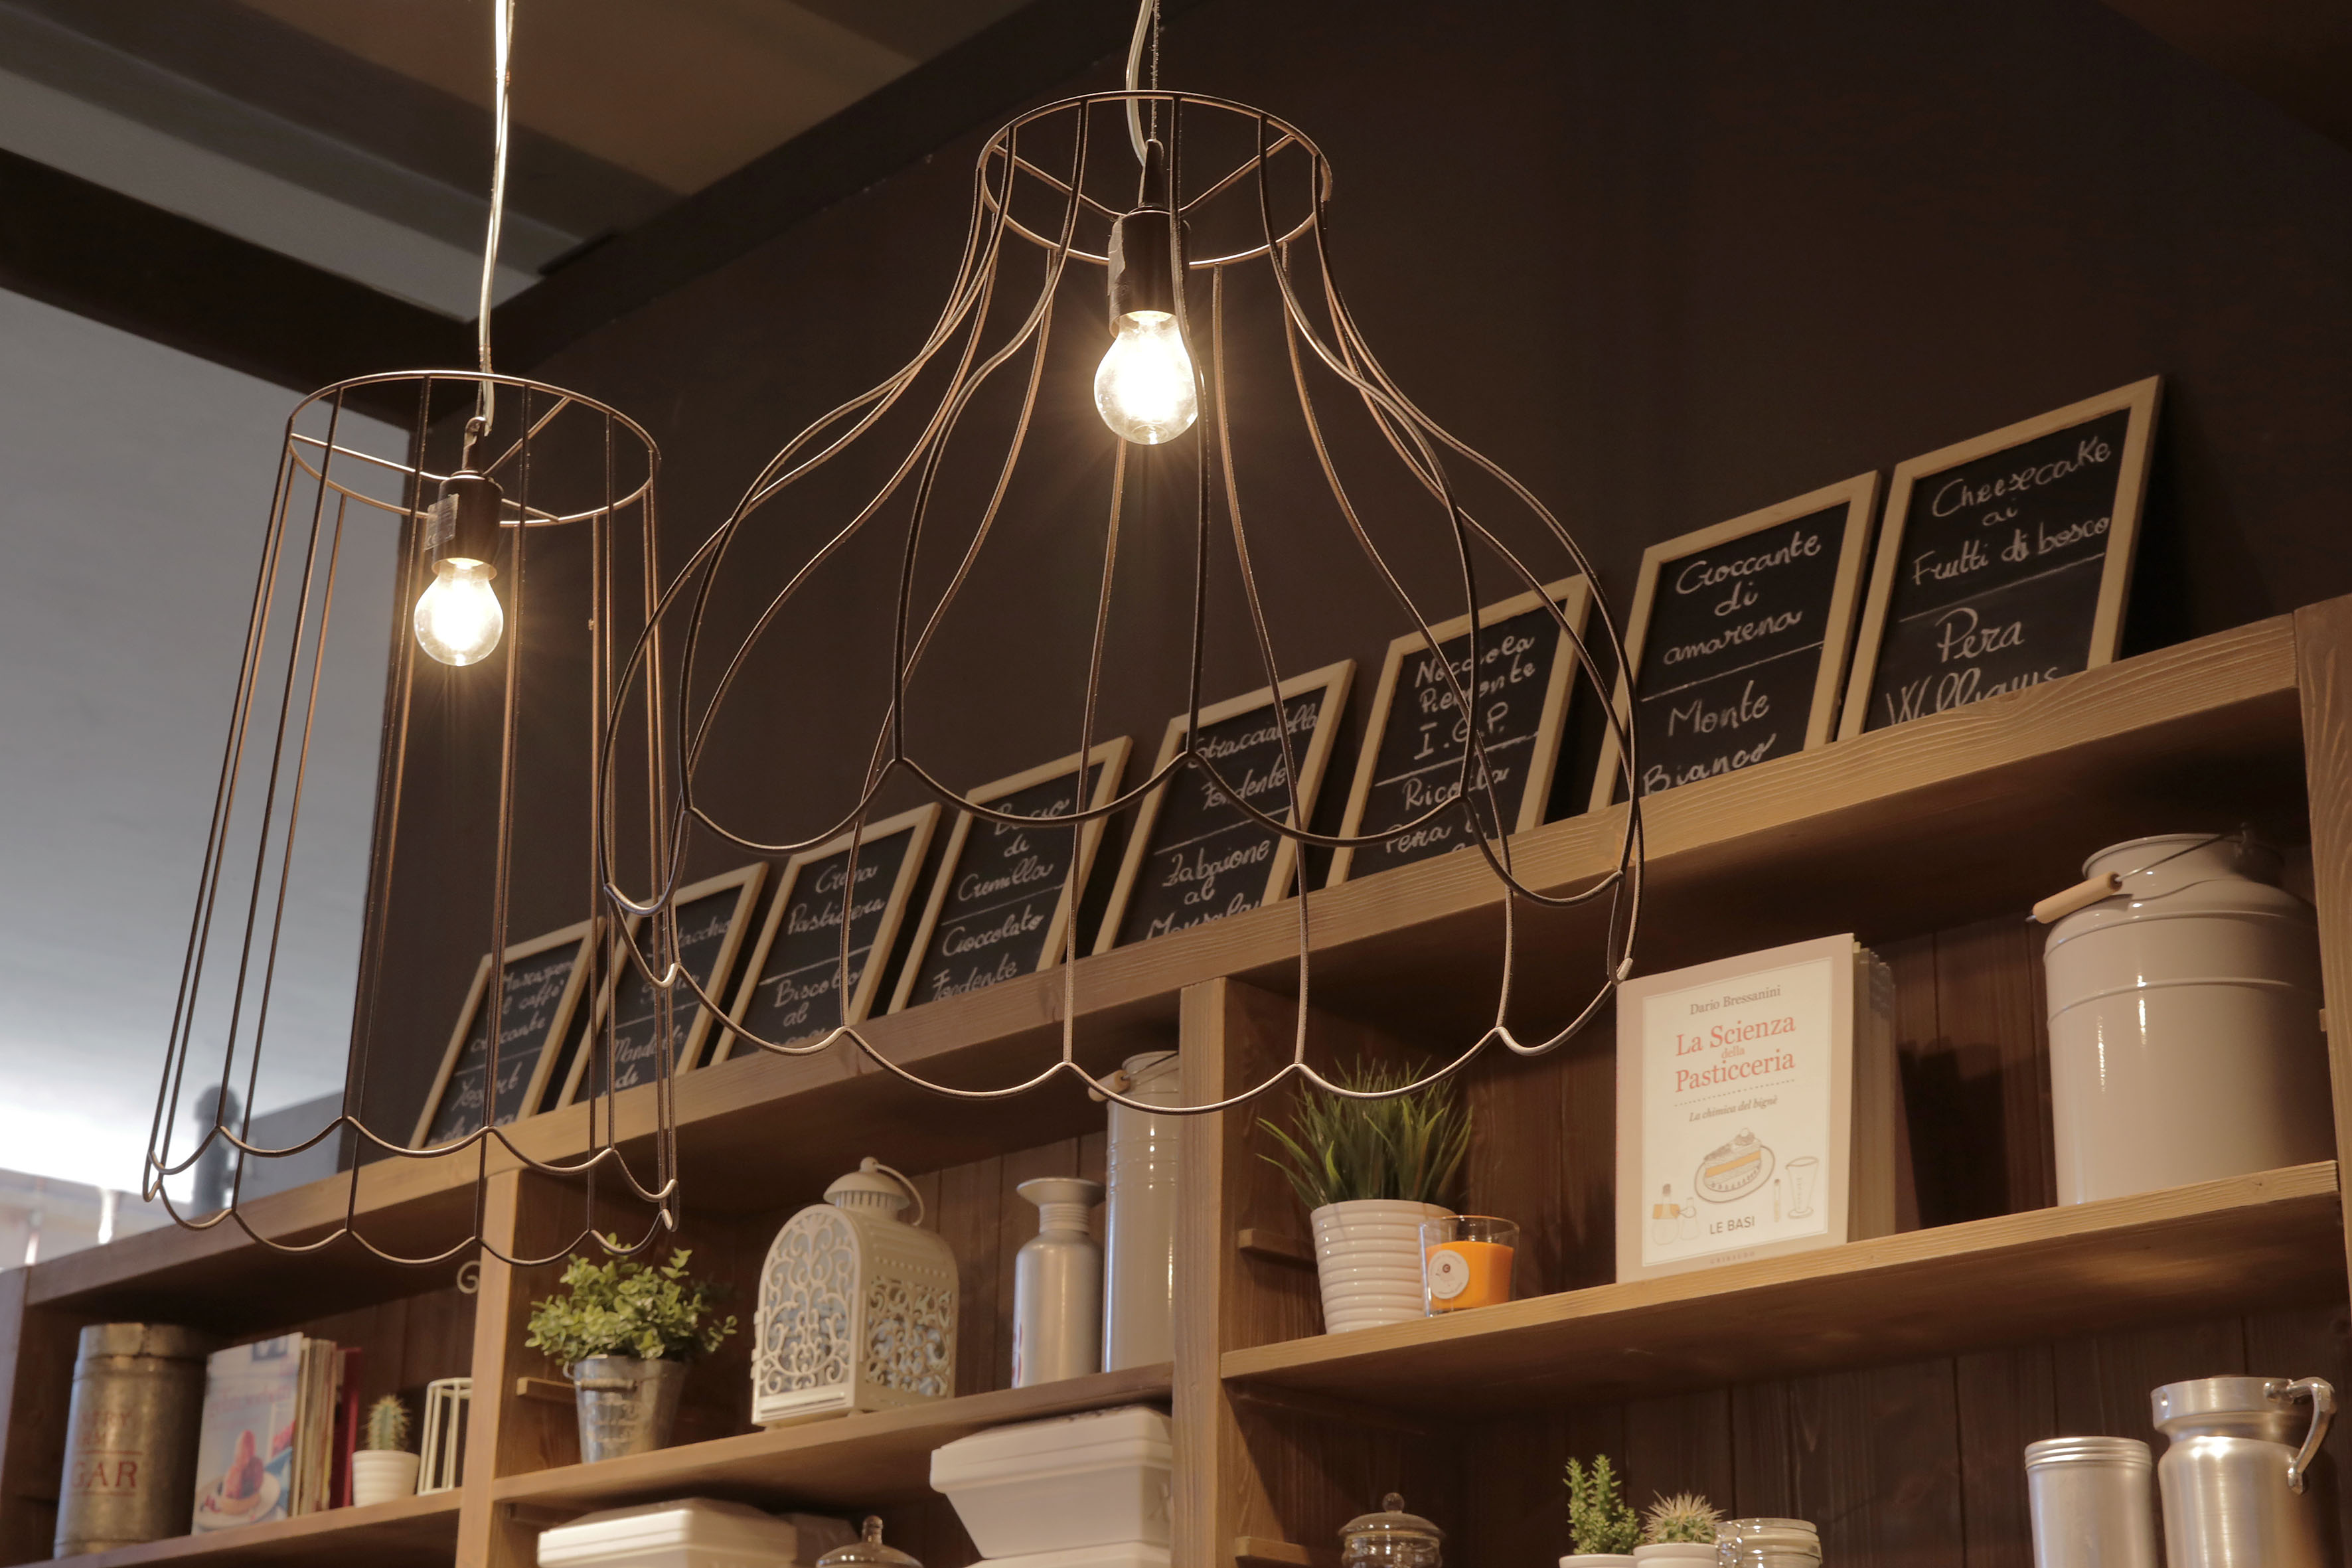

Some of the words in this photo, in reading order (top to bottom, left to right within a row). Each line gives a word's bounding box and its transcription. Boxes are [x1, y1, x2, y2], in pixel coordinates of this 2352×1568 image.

[1982, 497, 2018, 526] ai
[1676, 530, 1822, 594] Croccante
[1913, 539, 1990, 586] Frutti
[2000, 528, 2029, 562] di
[2037, 516, 2110, 555] bosco
[1713, 582, 1759, 616] di
[1663, 609, 1803, 665] amarena
[1935, 607, 2025, 663] Pera
[1415, 635, 1535, 688] Noccola
[1668, 680, 1770, 737] Monte
[1885, 666, 2058, 725] Wllams
[1642, 734, 1777, 796] Bianco
[1402, 766, 1510, 811] Ricota
[994, 798, 1071, 835] Bcio
[1184, 878, 1215, 905] al
[788, 898, 887, 935] Pasticera
[943, 904, 1044, 957] Cioccolato
[774, 965, 864, 1008] Biscoto
[1689, 999, 1720, 1016] Dario
[1723, 984, 1782, 1008] Bressanini
[783, 1001, 809, 1027] al
[1676, 1033, 1703, 1056] La
[1709, 1016, 1796, 1049] Scienza
[1675, 1048, 1796, 1093] Pasticceria
[1721, 1044, 1745, 1059] della
[451, 1061, 522, 1111] Yogrt
[1689, 1111, 1701, 1123] La
[1702, 1103, 1736, 1121] chimica
[1737, 1099, 1751, 1113] del
[1753, 1095, 1778, 1112] bignè
[1709, 1220, 1724, 1235] LE
[1727, 1215, 1755, 1233] BASI
